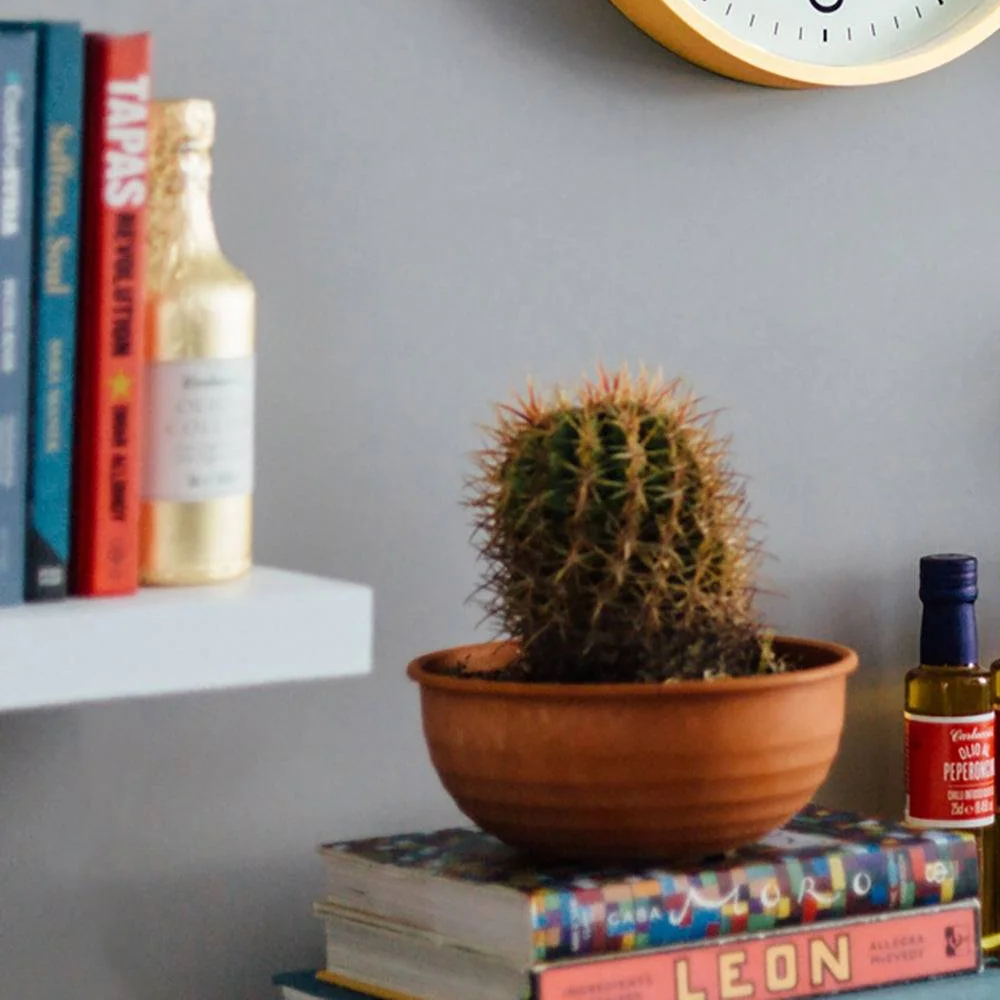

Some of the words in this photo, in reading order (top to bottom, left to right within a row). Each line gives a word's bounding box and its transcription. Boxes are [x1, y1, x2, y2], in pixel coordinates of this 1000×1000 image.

[103, 73, 150, 209] TAPAS
[112, 211, 136, 357] REVOLUTION
[607, 904, 661, 927] CASA
[675, 933, 851, 1000] LEON
